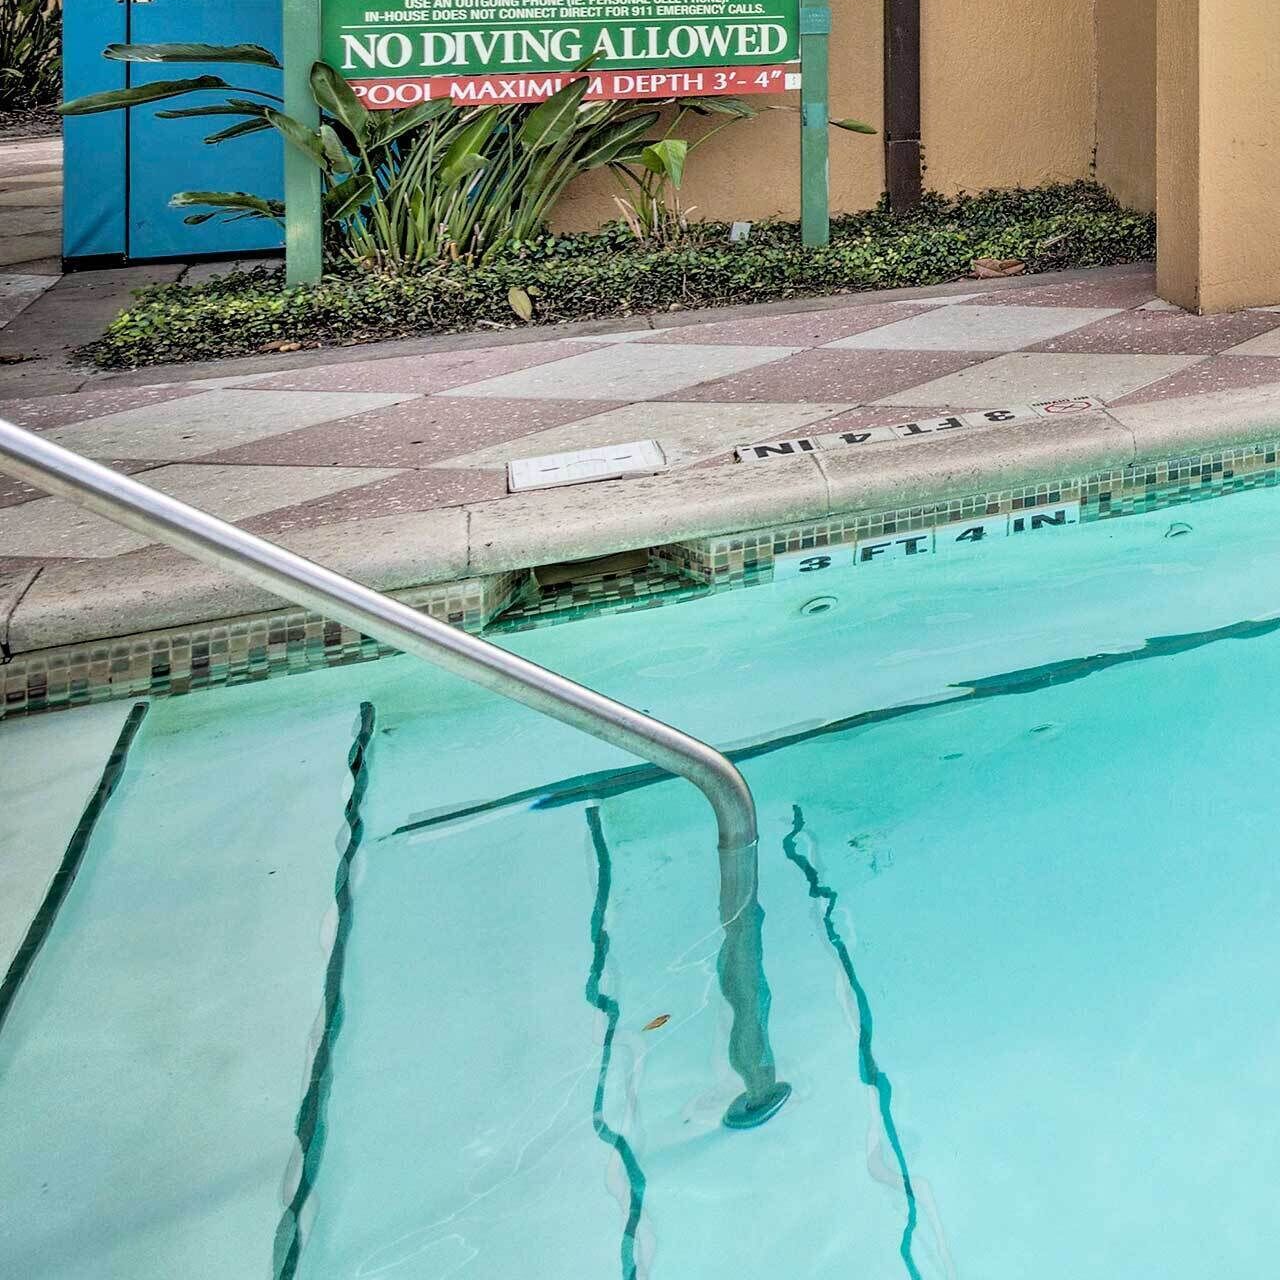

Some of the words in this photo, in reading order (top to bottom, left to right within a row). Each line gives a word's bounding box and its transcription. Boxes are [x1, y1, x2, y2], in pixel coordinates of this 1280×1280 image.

[341, 32, 412, 69] NO
[420, 28, 582, 67] DIVING
[593, 23, 787, 62] ALLOWED
[613, 72, 703, 95] DEPTH
[983, 410, 1016, 422] 3
[898, 417, 963, 436] FT.
[839, 432, 872, 444] 4
[742, 439, 815, 458] IN.
[799, 556, 831, 572] 3
[861, 535, 928, 562] FT.
[955, 526, 988, 542] 4
[1013, 509, 1076, 533] IN.
